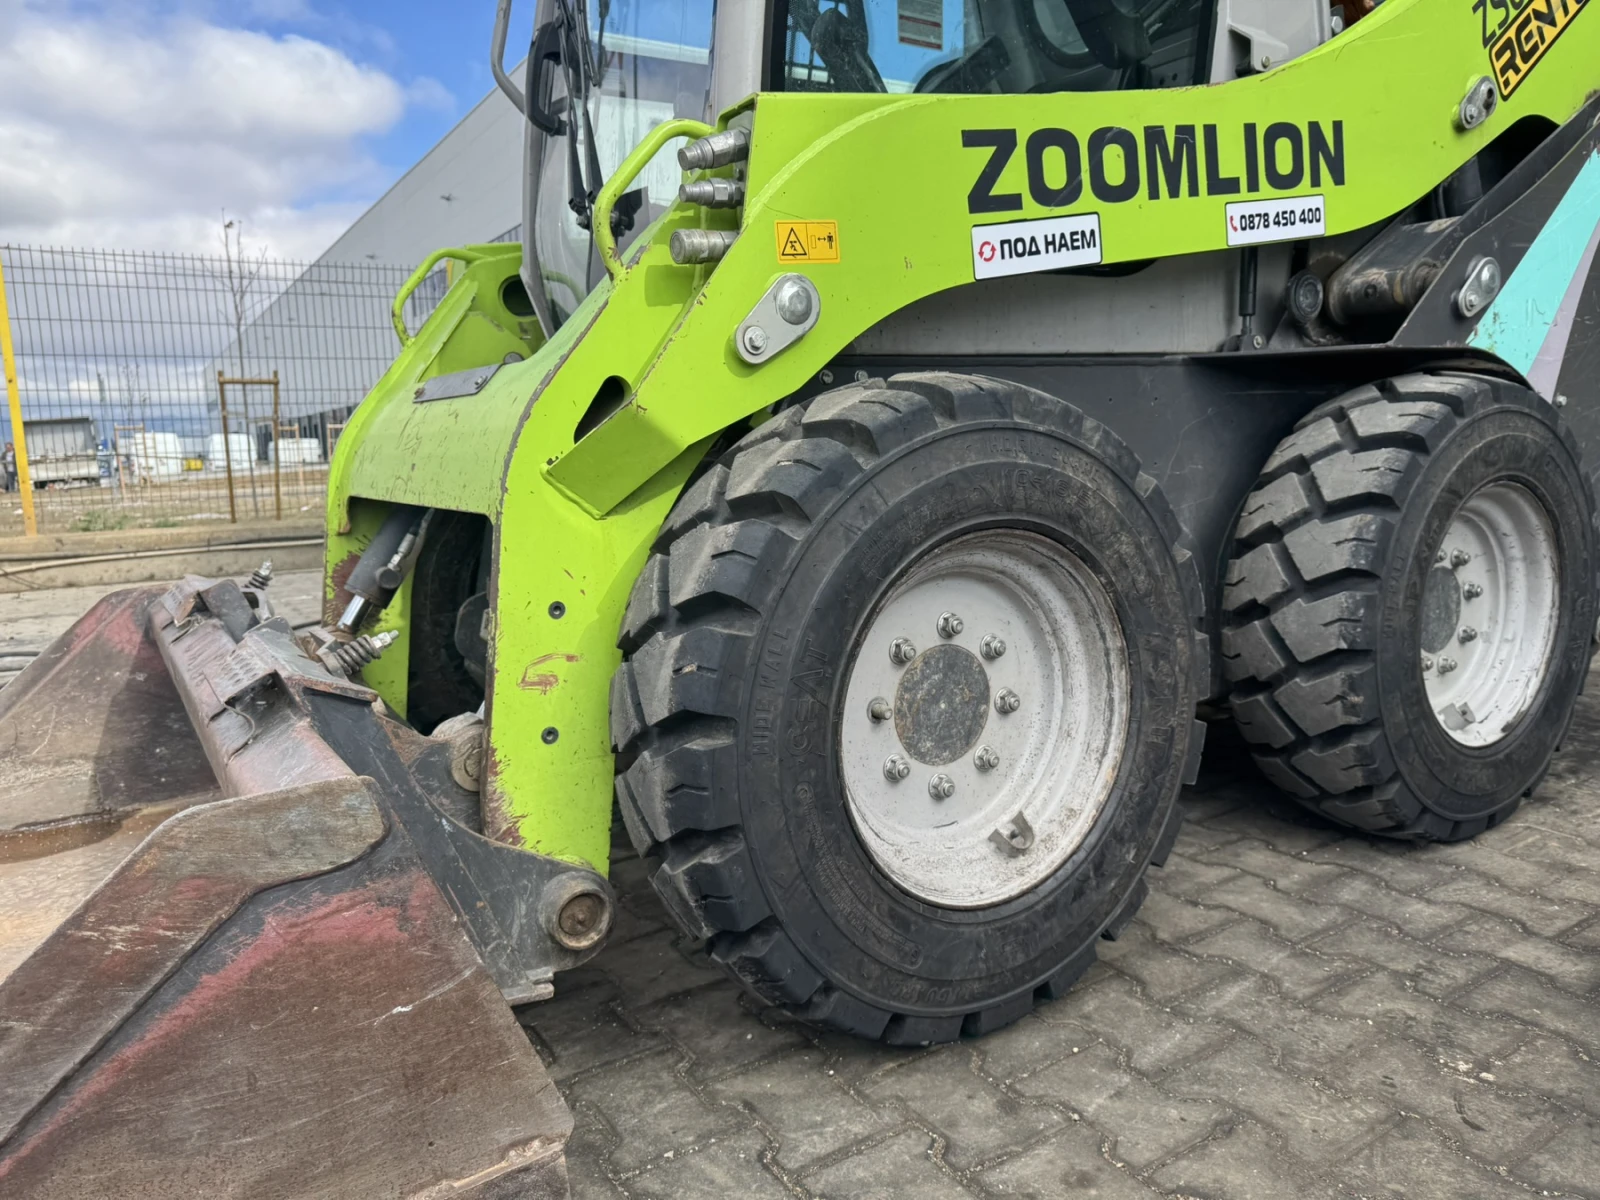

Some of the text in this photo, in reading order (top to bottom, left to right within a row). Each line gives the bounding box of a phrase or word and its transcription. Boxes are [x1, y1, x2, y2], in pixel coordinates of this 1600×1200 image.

[961, 120, 1345, 214] ZOOMLION
[1239, 207, 1321, 231] 0878 450 400
[1000, 228, 1096, 260] ПОД НАЕМ
